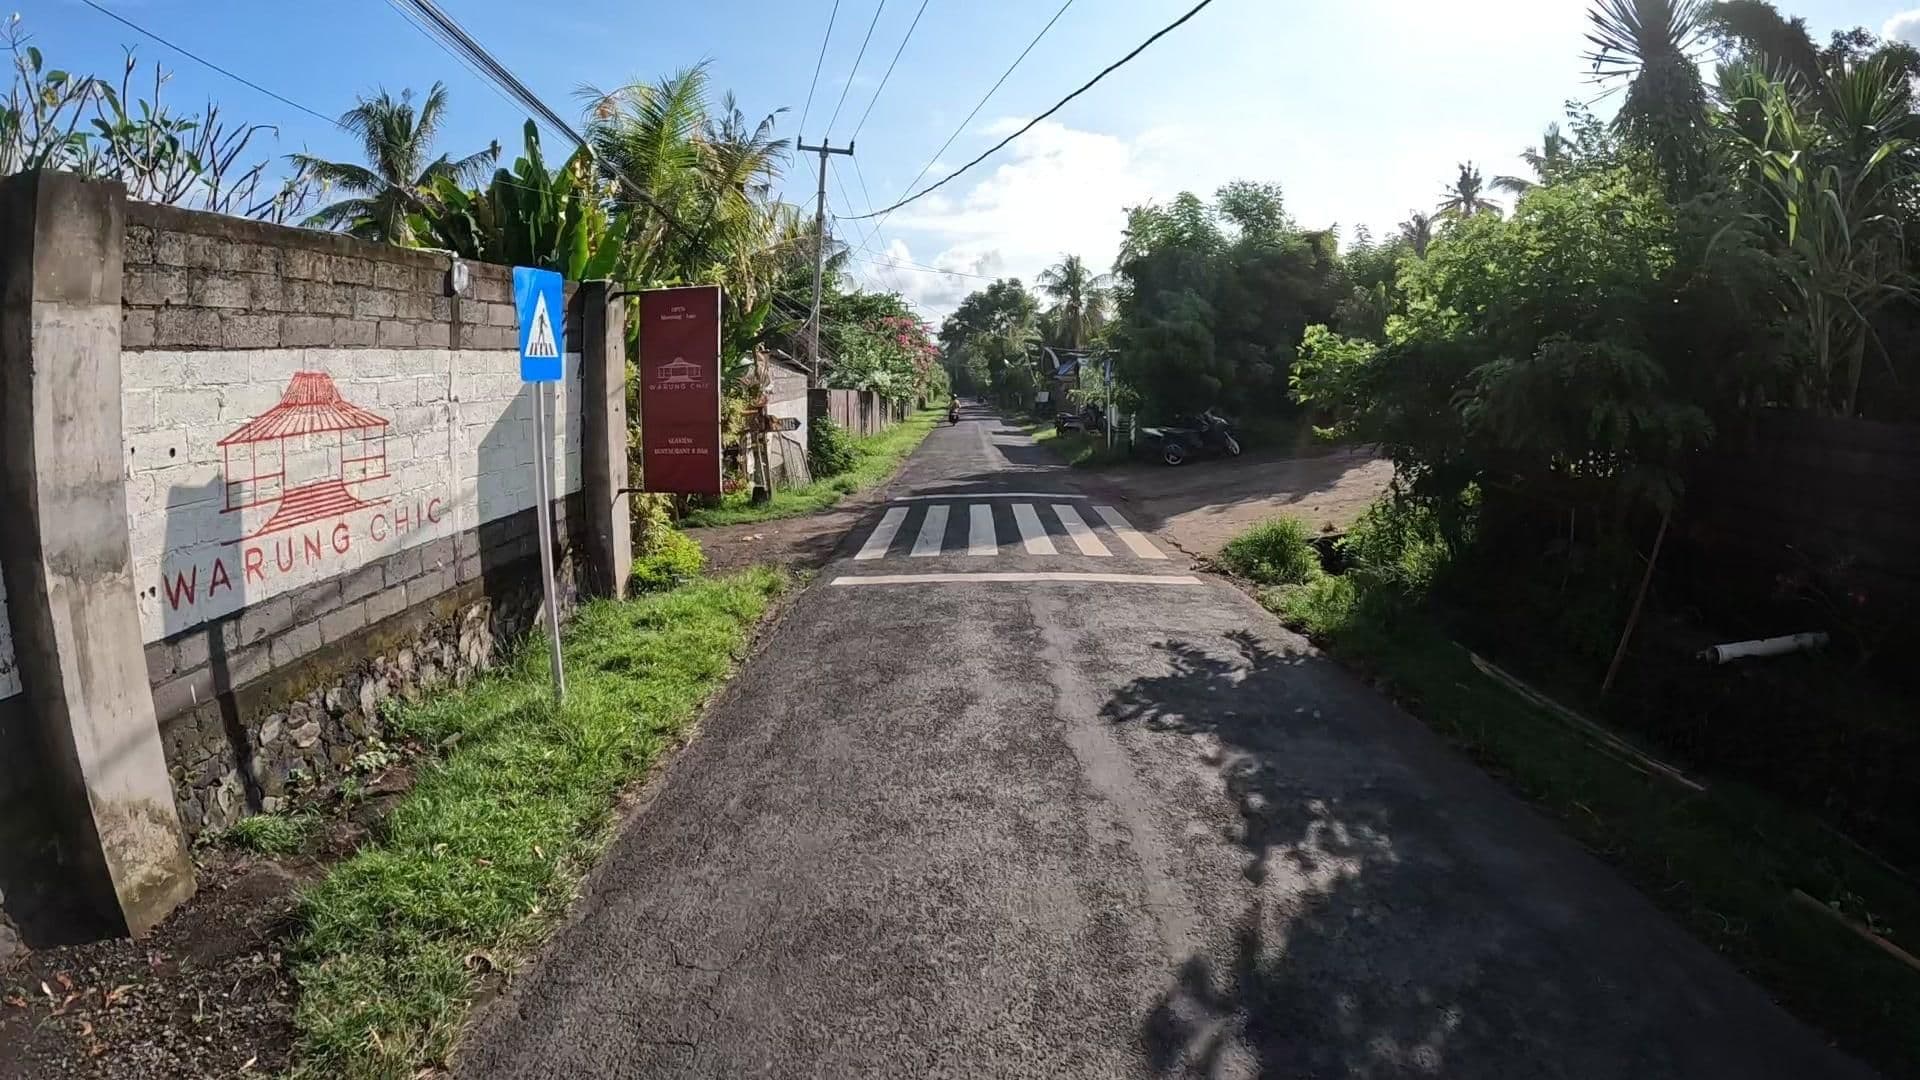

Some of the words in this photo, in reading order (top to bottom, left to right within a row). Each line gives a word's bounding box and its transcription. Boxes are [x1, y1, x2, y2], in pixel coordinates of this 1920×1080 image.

[648, 383, 687, 391] WARUNG
[163, 523, 350, 611] WARUNG
[370, 497, 442, 542] CHIC
